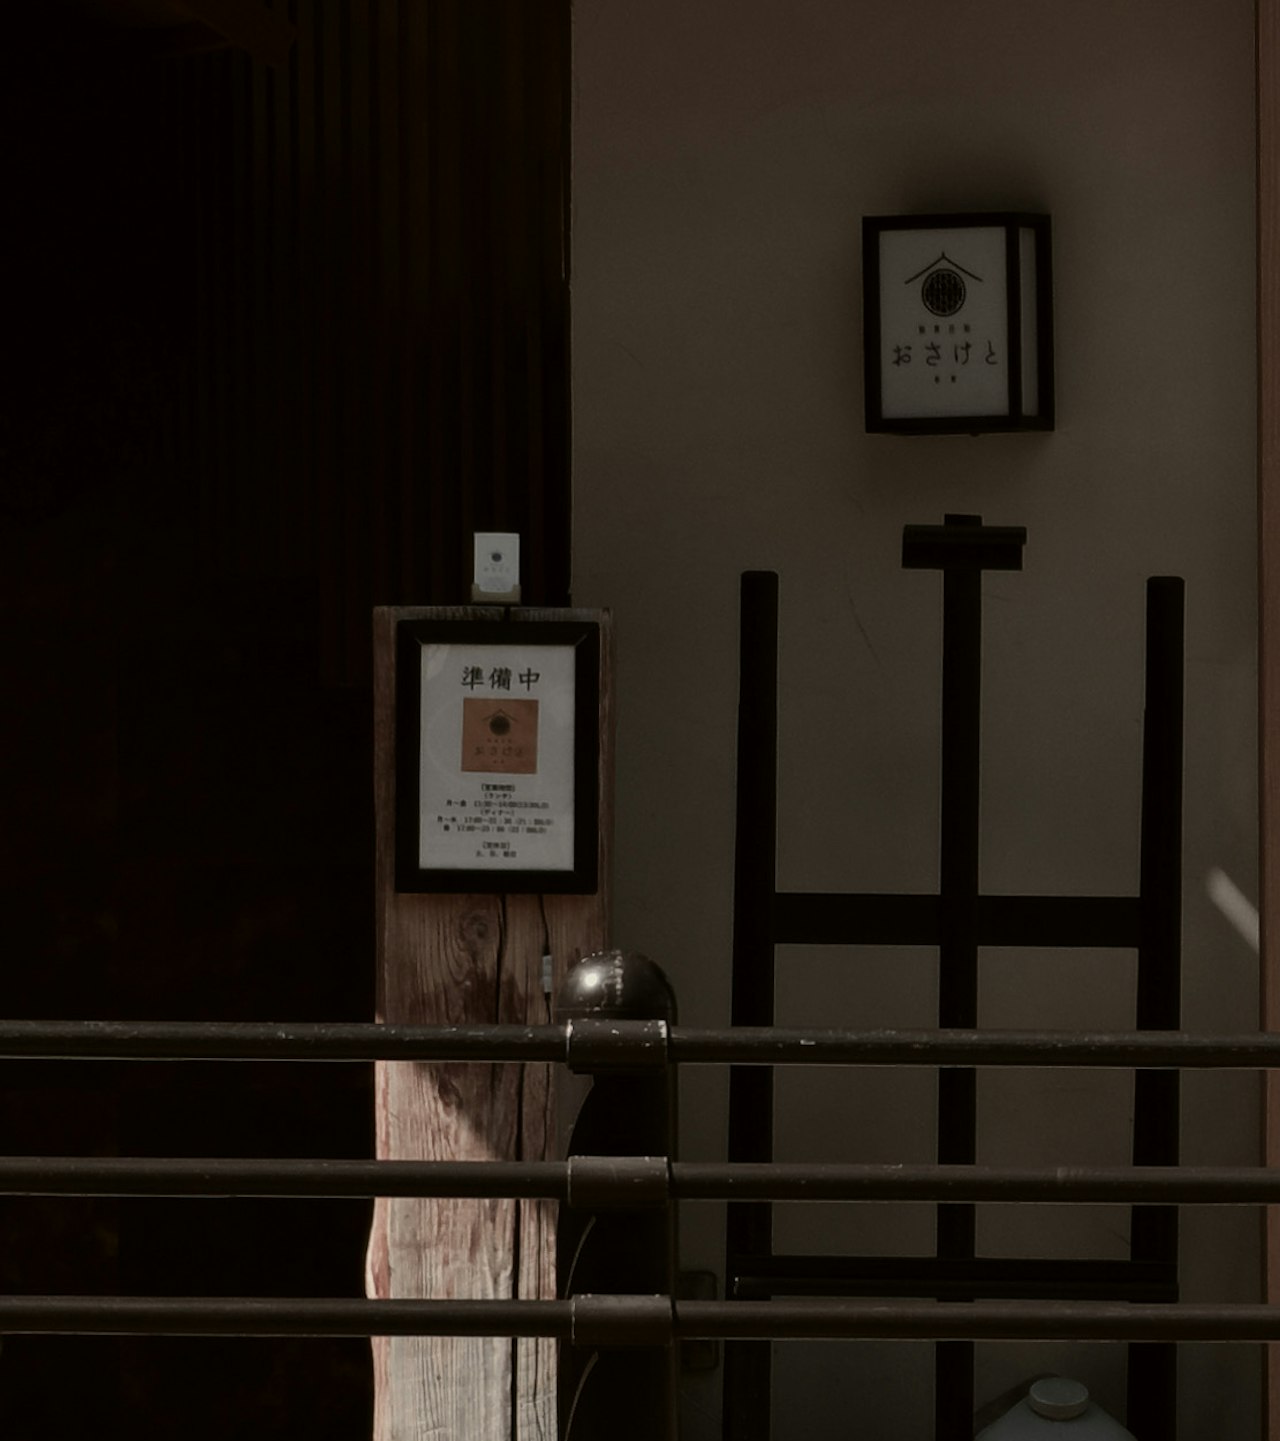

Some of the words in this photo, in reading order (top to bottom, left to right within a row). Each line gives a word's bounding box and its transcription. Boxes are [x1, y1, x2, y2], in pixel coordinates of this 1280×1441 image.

[892, 340, 998, 366] おさけと
[461, 666, 540, 691] 準備中
